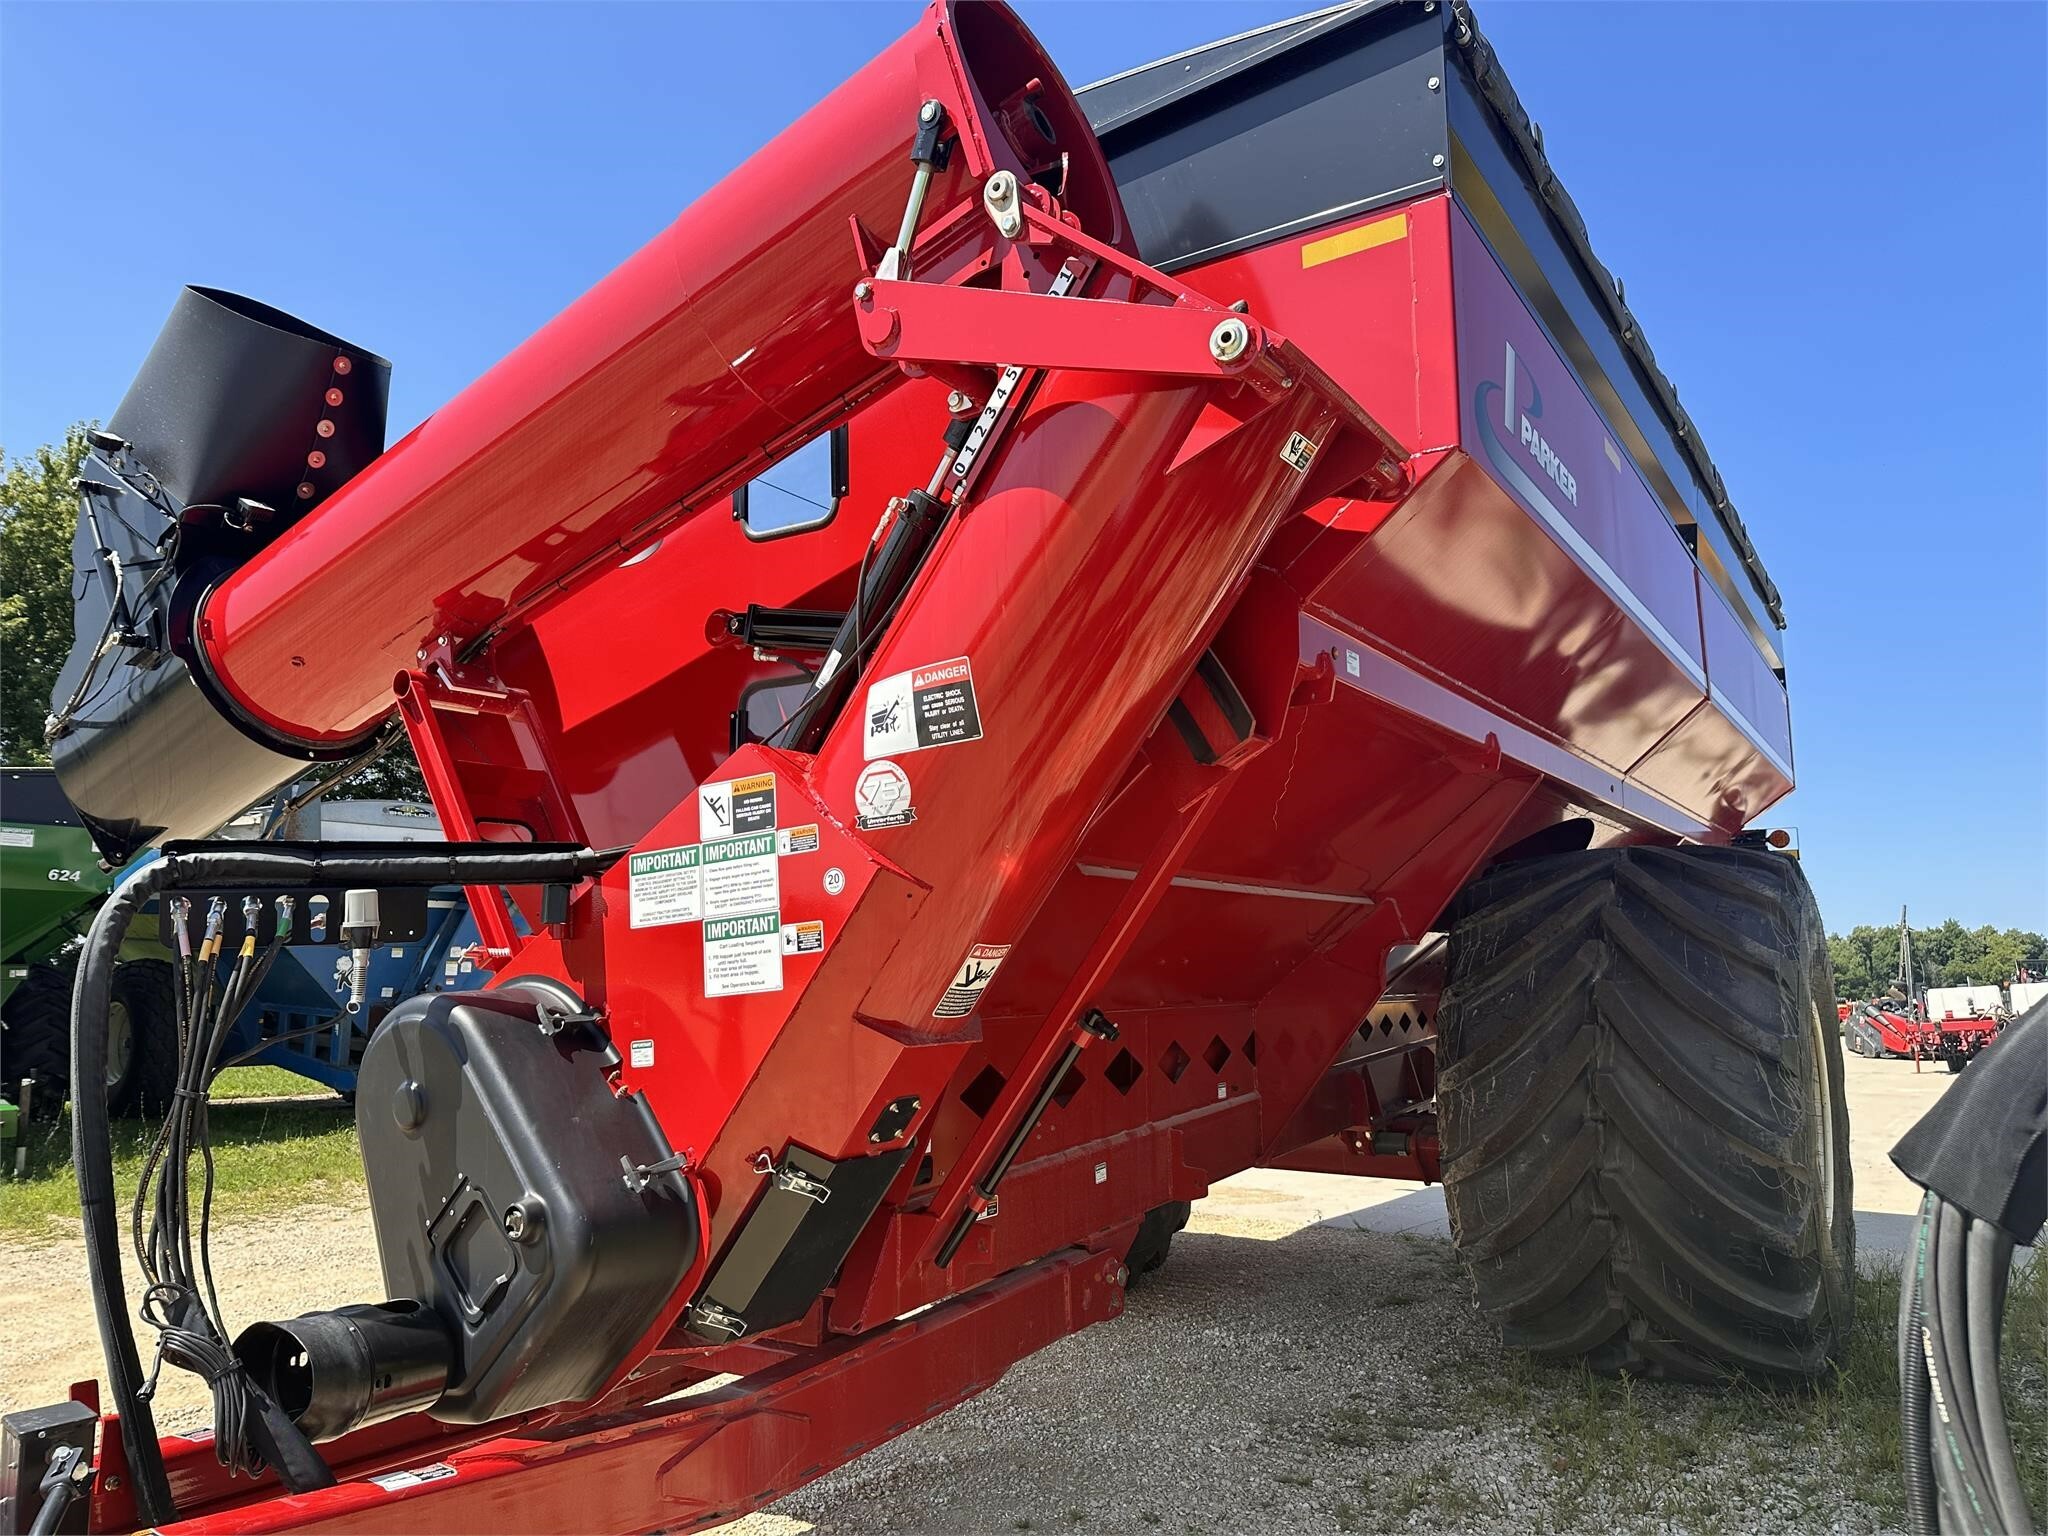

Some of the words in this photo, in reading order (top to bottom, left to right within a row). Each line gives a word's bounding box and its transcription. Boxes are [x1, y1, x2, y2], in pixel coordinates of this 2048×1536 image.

[954, 462, 966, 474] 0
[965, 445, 976, 456] 1
[974, 425, 988, 438] 2
[984, 406, 997, 419] 3
[996, 387, 1007, 400] 4
[1005, 368, 1018, 381] 5
[1521, 414, 1577, 507] PARKER
[925, 665, 967, 683] DANGER
[740, 779, 772, 791] WARNING
[705, 836, 772, 862] IMPORTANT
[633, 849, 696, 873] IMPORTANT
[48, 869, 80, 881] 624
[828, 873, 839, 884] 20
[707, 915, 776, 939] IMPORTANT
[982, 948, 1007, 957] DANGER
